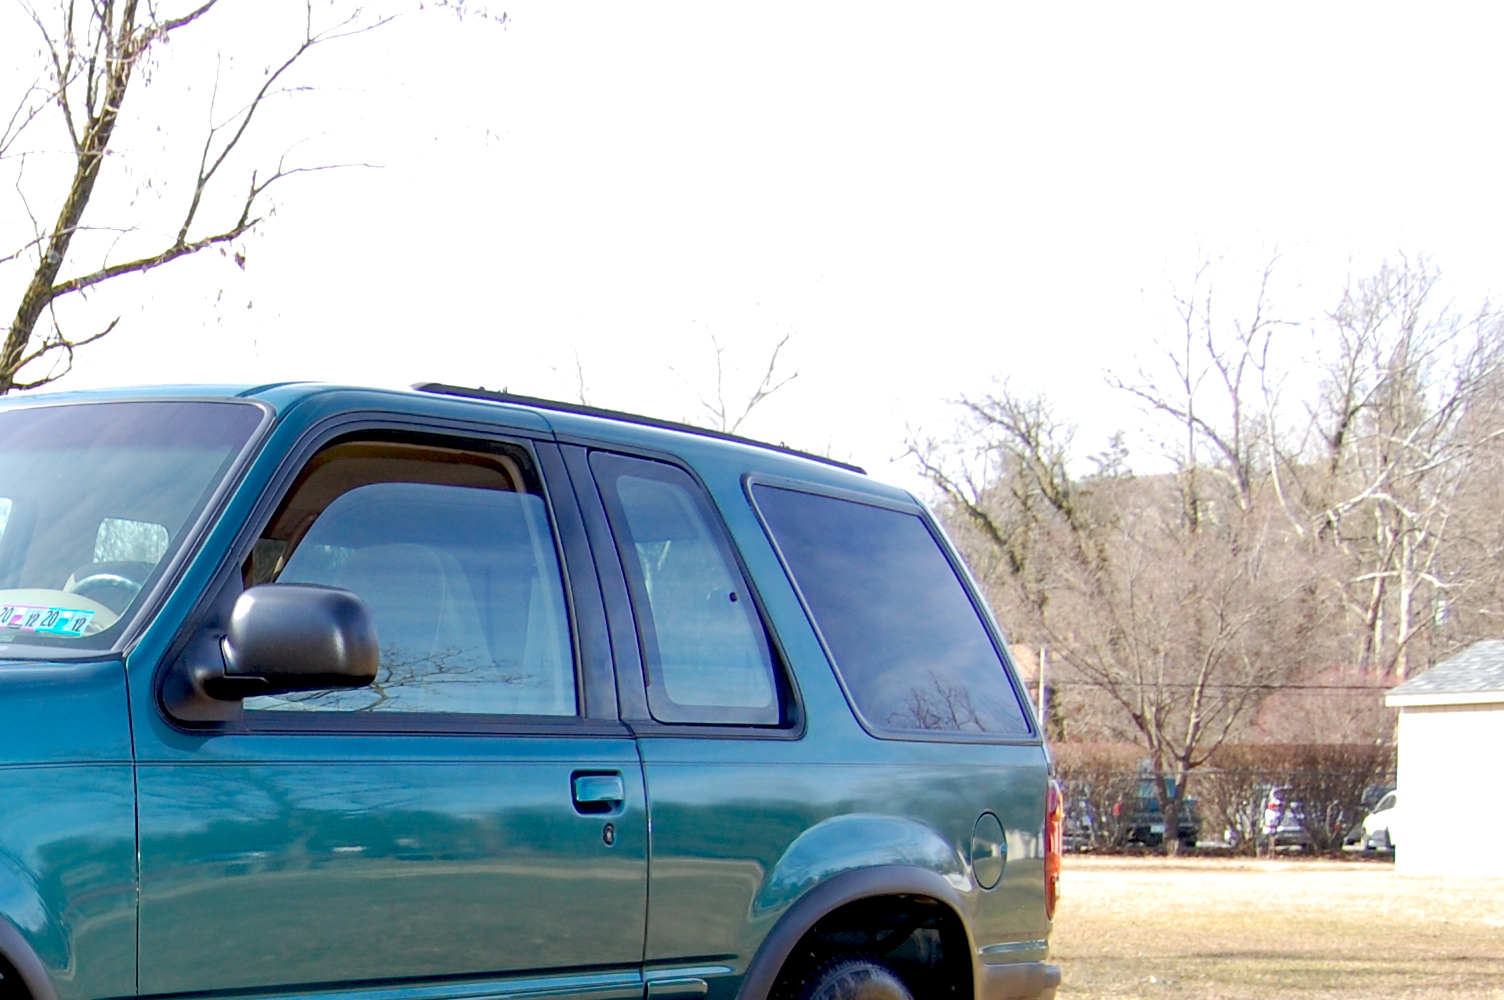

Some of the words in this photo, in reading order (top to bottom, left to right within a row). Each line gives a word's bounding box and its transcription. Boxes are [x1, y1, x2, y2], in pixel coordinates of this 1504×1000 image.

[25, 613, 40, 627] 12
[40, 610, 59, 627] 20
[72, 617, 86, 632] 12
